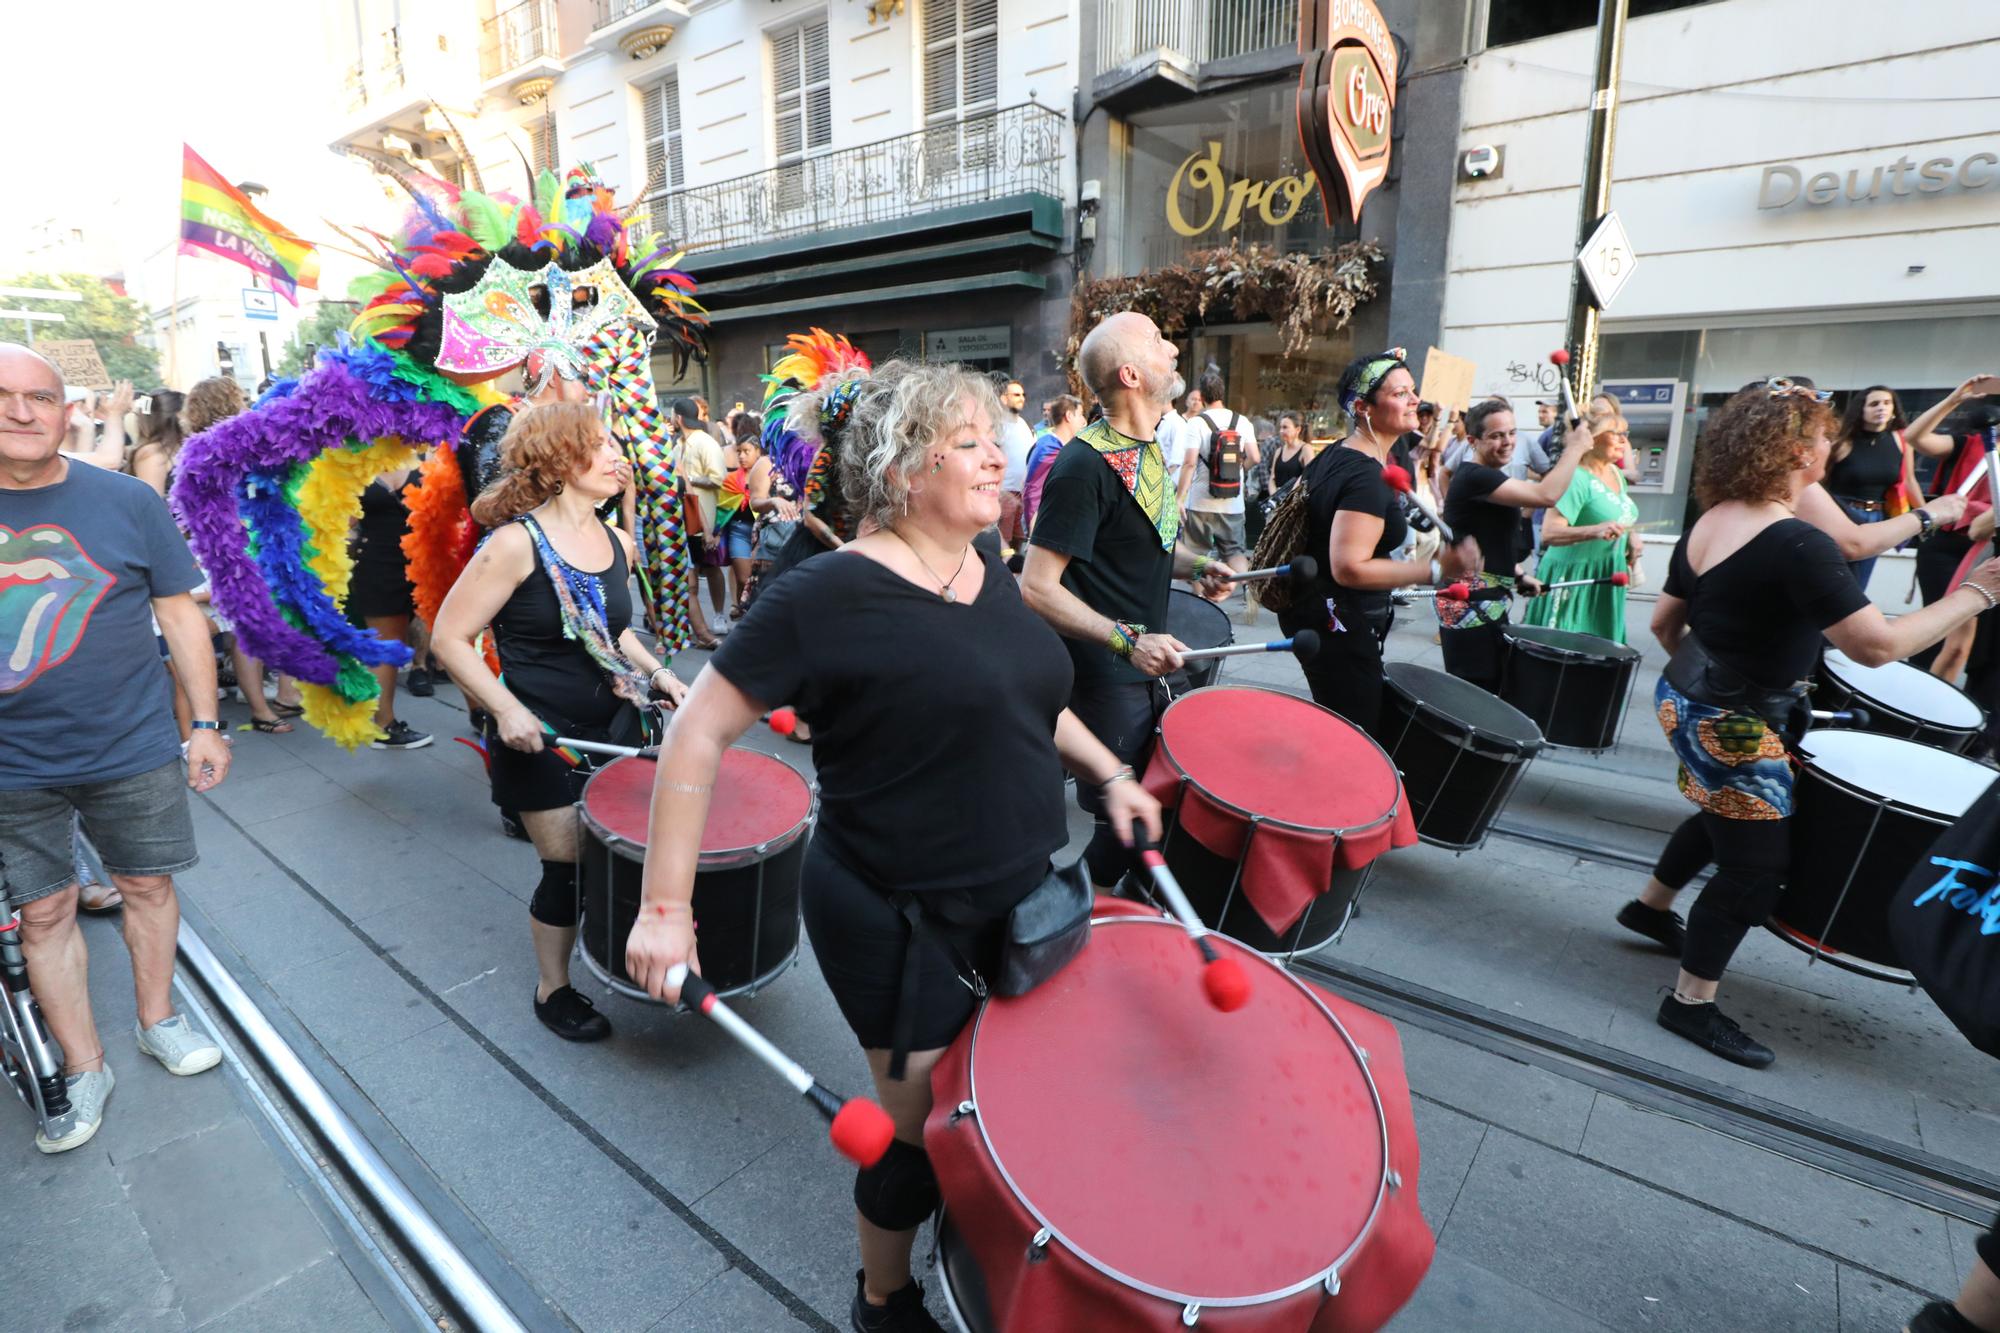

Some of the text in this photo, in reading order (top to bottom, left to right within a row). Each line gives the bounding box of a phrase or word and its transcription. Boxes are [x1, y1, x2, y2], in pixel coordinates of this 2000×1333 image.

[1348, 64, 1387, 135] Oro
[1166, 141, 1316, 237] Oro
[1757, 152, 2000, 211] Deutsc
[215, 230, 238, 251] LA
[1600, 247, 1621, 276] 15
